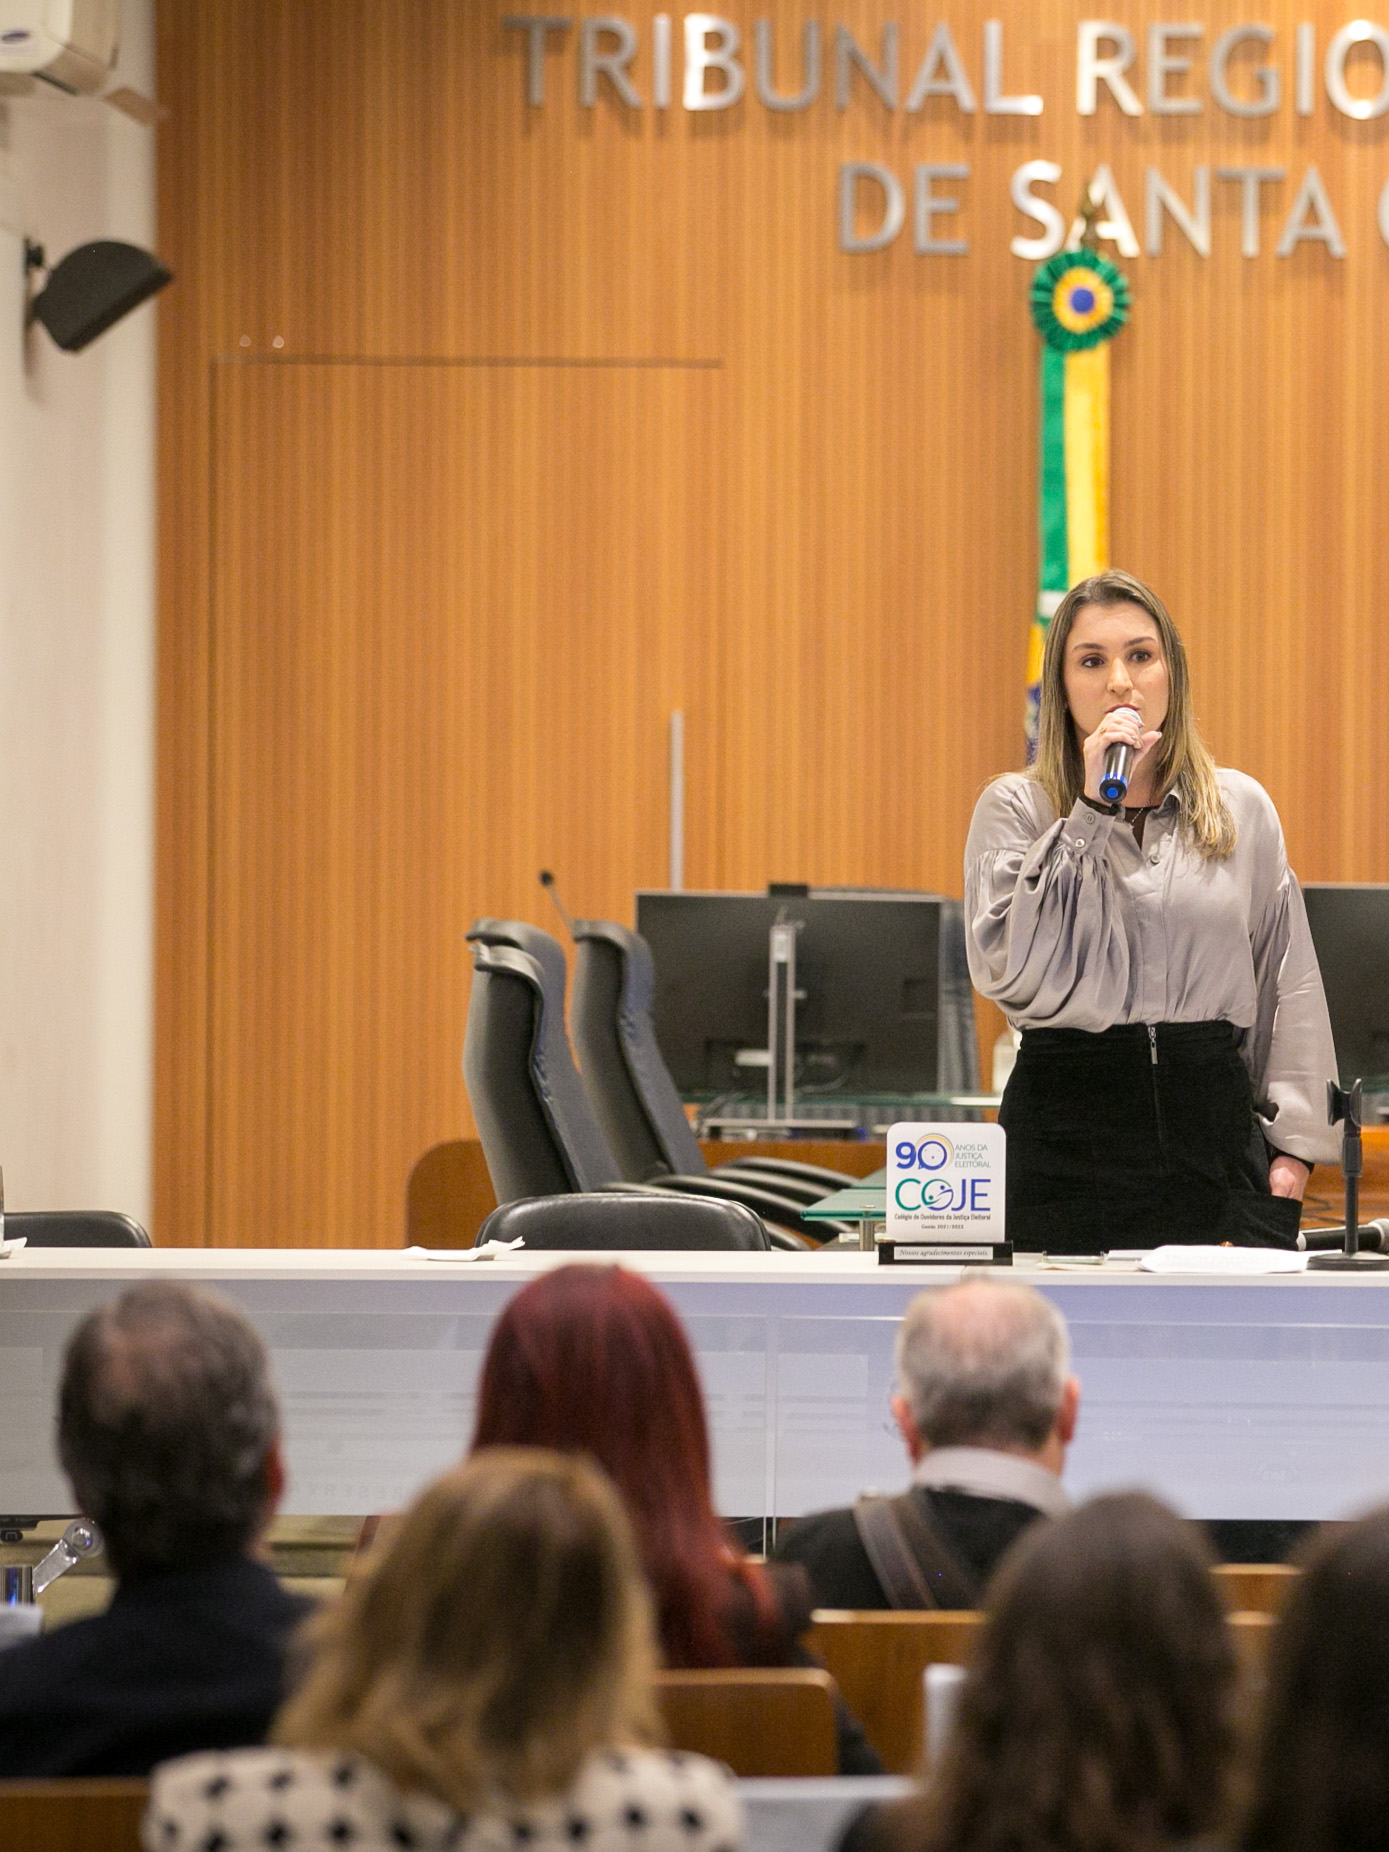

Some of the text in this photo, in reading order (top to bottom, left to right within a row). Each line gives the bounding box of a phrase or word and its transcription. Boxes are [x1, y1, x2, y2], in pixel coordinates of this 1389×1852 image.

[503, 13, 1043, 117] TRIBUNAL
[839, 162, 970, 256] DE
[1010, 159, 1345, 261] SANTA
[895, 1140, 948, 1171] 90
[954, 1144, 989, 1152] ANOS DA
[954, 1152, 983, 1161] JUSTIÇA
[954, 1161, 991, 1169] ELEITORAL
[895, 1178, 992, 1212] COJE
[894, 1213, 912, 1221] Colégio
